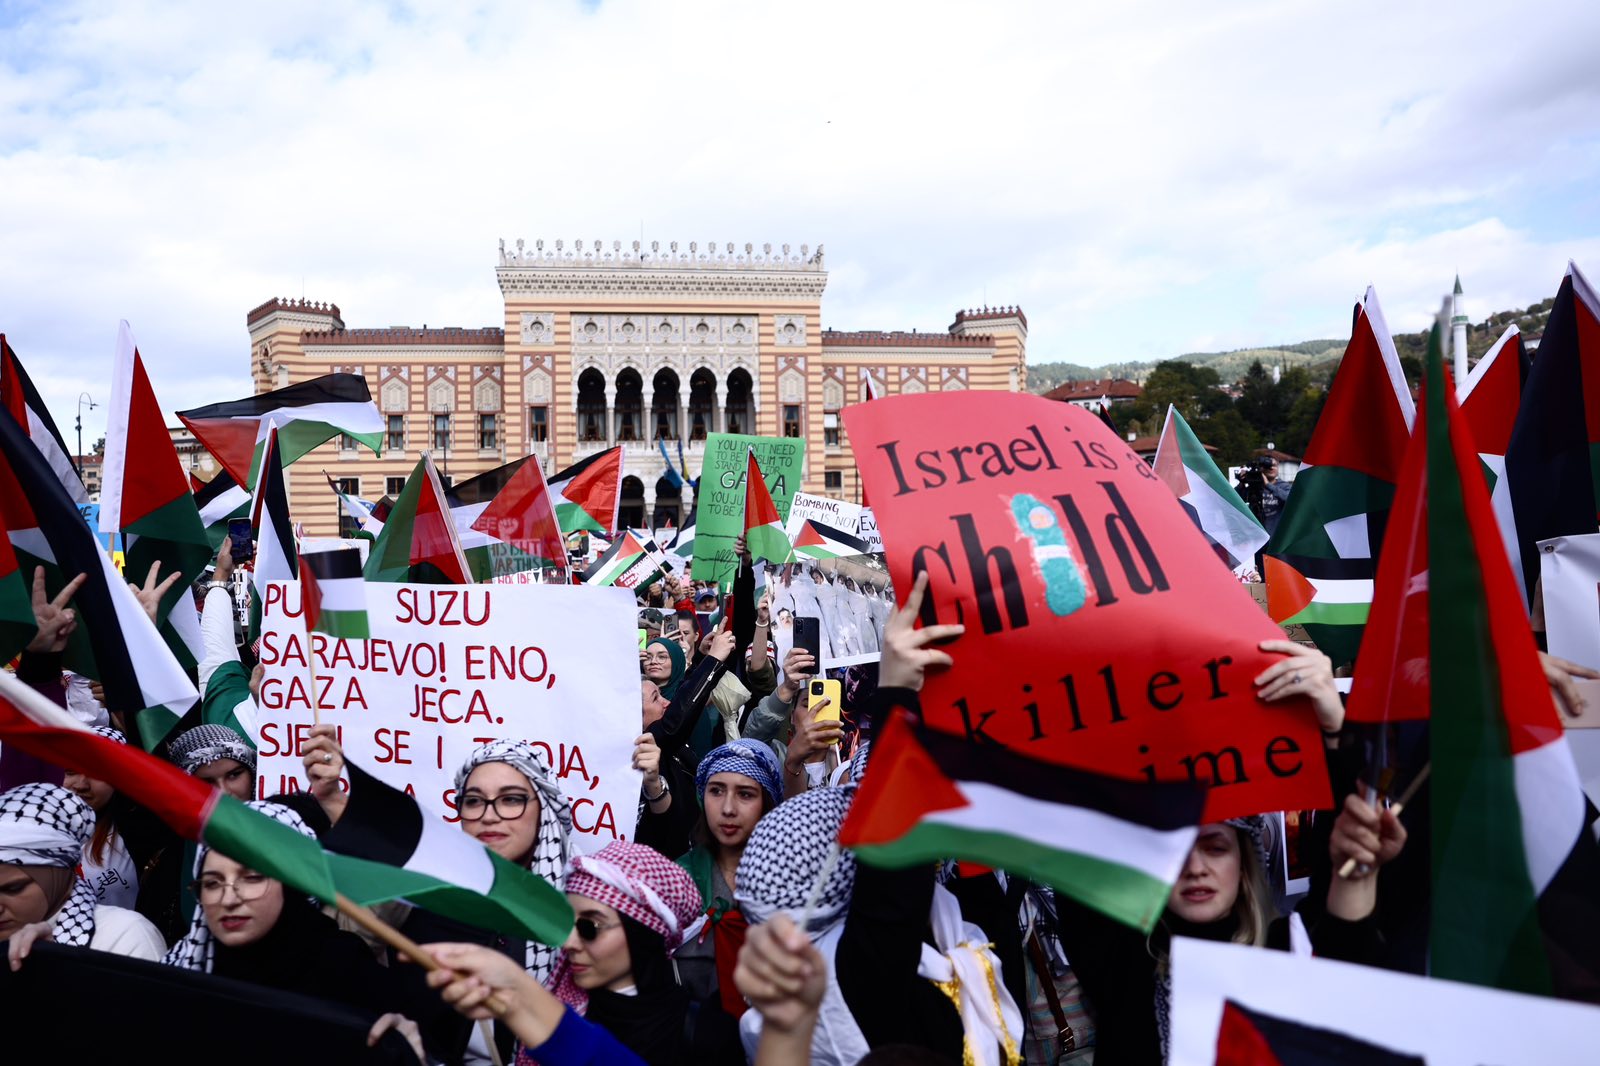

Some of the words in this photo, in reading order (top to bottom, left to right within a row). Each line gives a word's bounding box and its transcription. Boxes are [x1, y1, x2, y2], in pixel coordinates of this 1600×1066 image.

[715, 451, 728, 461] TO
[730, 452, 743, 463] BE
[745, 453, 776, 466] SLIM
[778, 456, 793, 468] TO
[717, 440, 737, 452] YOU
[769, 443, 797, 456] NEED
[876, 425, 1062, 497] Israel
[1065, 426, 1118, 470] is
[1126, 453, 1157, 480] a
[714, 460, 742, 472] STAND
[765, 466, 780, 476] FOR
[707, 504, 721, 515] TO
[722, 506, 736, 517] BE
[711, 491, 730, 505] YOU
[794, 495, 840, 515] BOMBING
[820, 513, 830, 524] IS
[834, 516, 857, 529] NOT
[396, 588, 490, 626] SUZU
[261, 631, 446, 683] SARAJEVO!
[465, 645, 556, 690] ENO,
[260, 676, 368, 710] GAZA
[409, 684, 504, 724] JECA.
[952, 655, 1232, 747] killer
[259, 723, 342, 757] SJEI
[374, 728, 412, 764] SE
[437, 735, 442, 769] I
[1139, 735, 1303, 788] ime
